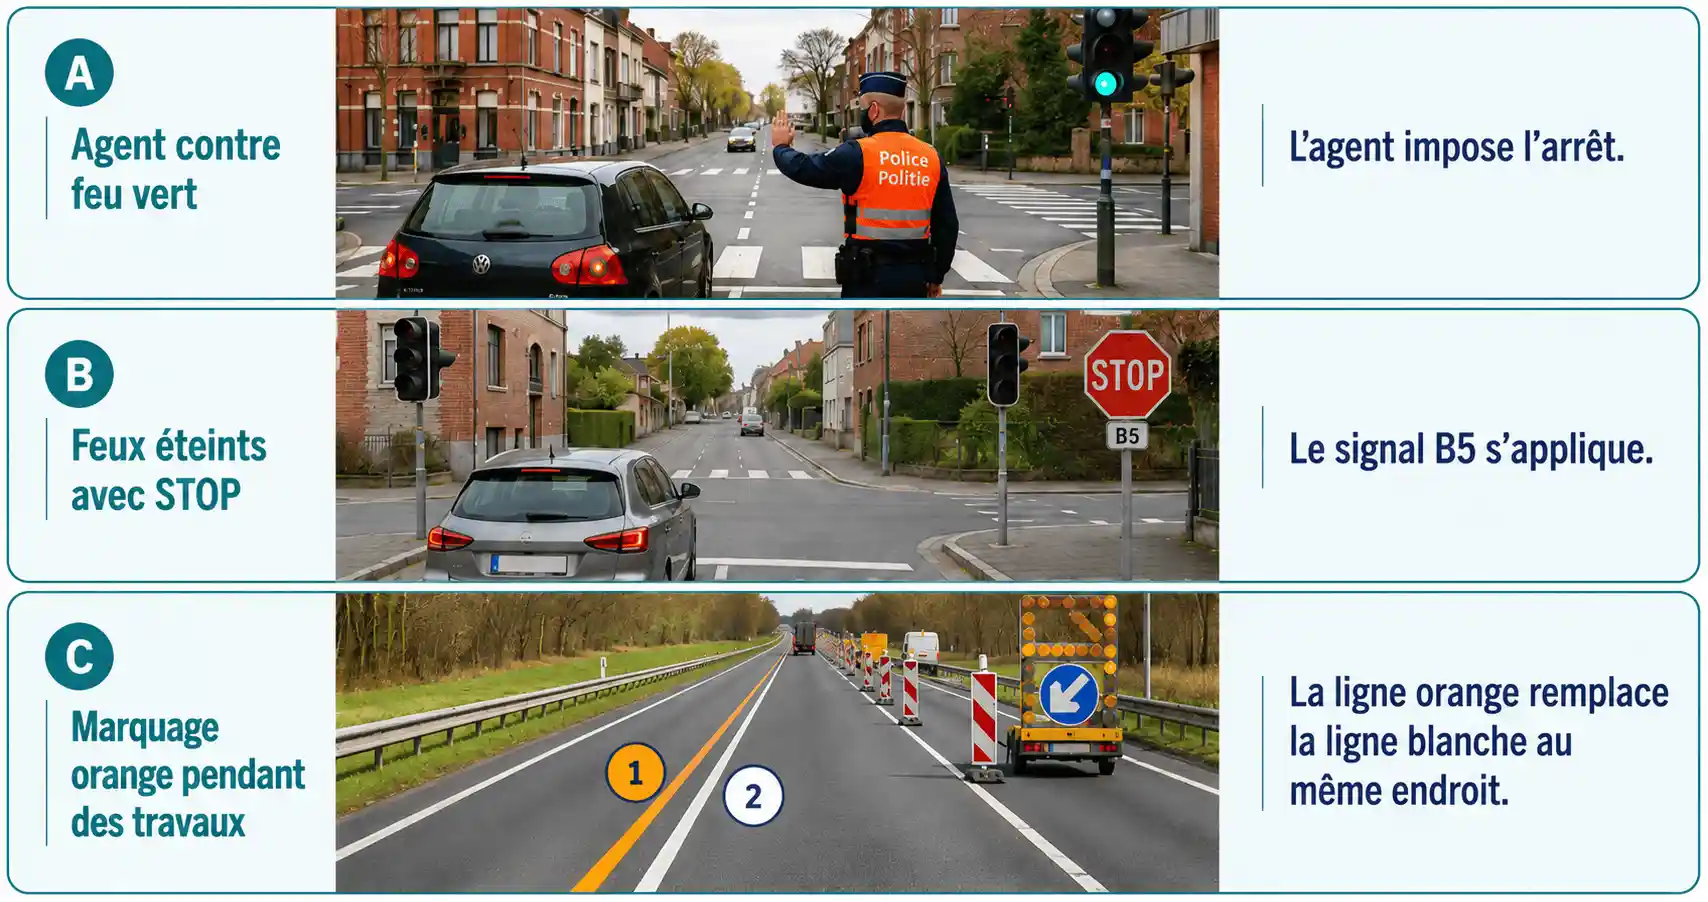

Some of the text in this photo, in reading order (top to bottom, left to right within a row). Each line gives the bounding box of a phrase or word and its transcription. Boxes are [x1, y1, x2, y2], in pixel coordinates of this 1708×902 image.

[879, 150, 929, 168] Police
[878, 169, 931, 187] Politie
[1091, 359, 1164, 391] STOP
[1116, 427, 1139, 444] B5
